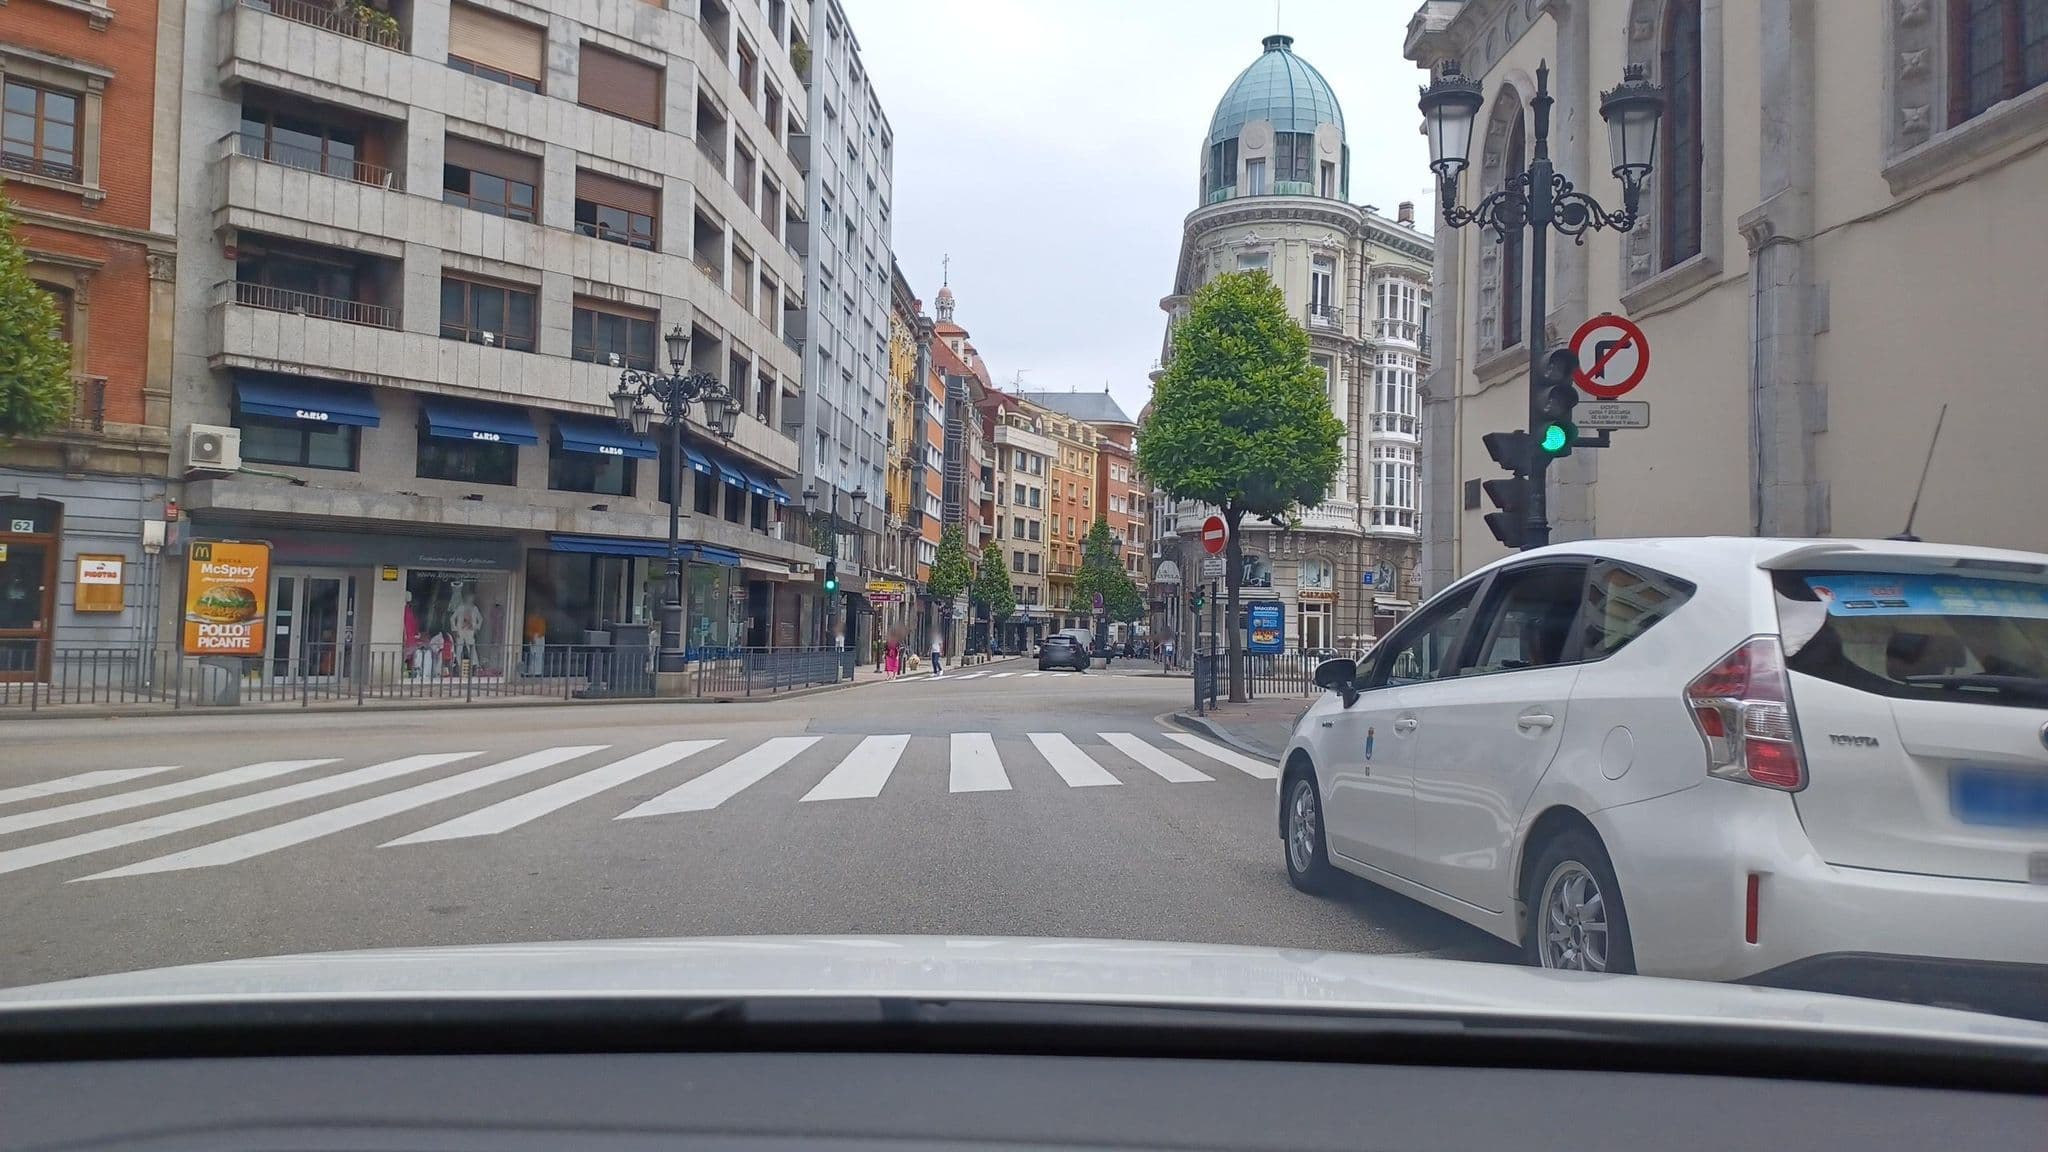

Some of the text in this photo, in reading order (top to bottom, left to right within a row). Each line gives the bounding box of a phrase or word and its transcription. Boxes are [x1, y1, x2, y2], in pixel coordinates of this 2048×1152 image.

[296, 410, 328, 421] CARLO
[473, 432, 500, 441] CARLO
[599, 446, 623, 455] CARLO
[14, 521, 31, 531] 62
[201, 563, 257, 578] McSpicy
[198, 624, 244, 636] POLLO
[197, 637, 251, 648] PICANTE
[1829, 734, 1880, 747] TOYOTA
